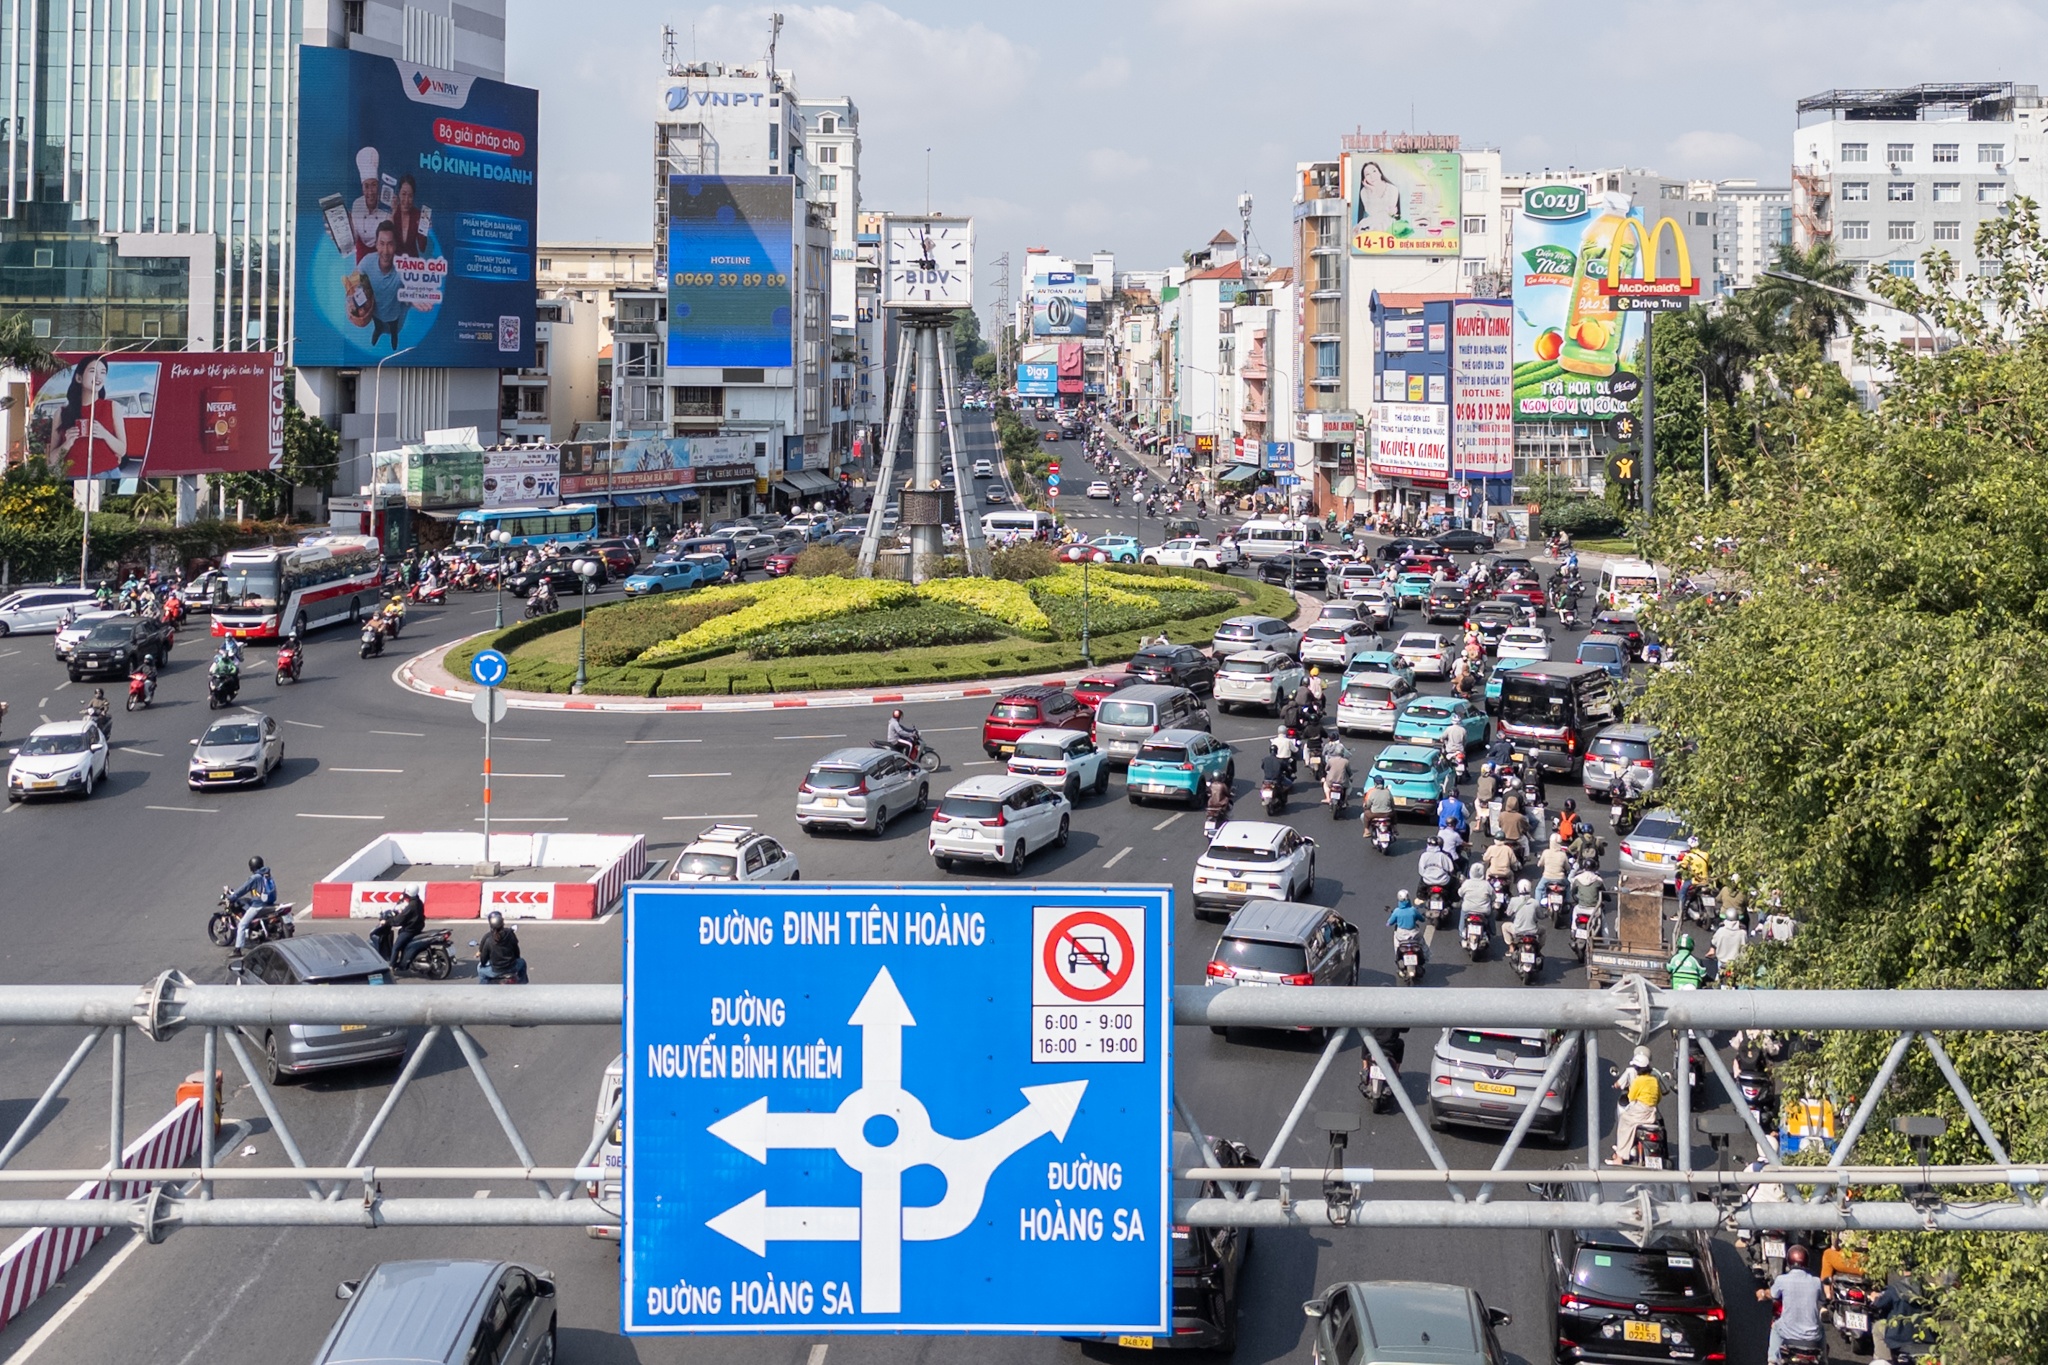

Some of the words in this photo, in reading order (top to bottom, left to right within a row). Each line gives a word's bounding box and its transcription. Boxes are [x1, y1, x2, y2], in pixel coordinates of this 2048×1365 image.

[432, 80, 459, 95] VNPAY
[694, 92, 764, 107] VNPT
[440, 124, 453, 142] Bộ
[454, 127, 473, 144] giải
[475, 131, 500, 149] pháp
[502, 137, 520, 151] cho
[420, 150, 442, 173] HỘ
[444, 157, 481, 178] KINH
[483, 164, 533, 185] DOANH
[1530, 191, 1581, 212] Cozy
[1355, 236, 1395, 249] 14-16
[396, 257, 425, 271] TẶNG
[428, 259, 446, 272] GÓI
[710, 256, 750, 265] HOTLINE
[1537, 257, 1571, 274] Mới
[403, 272, 419, 282] ƯU
[674, 273, 714, 287] 0969
[718, 273, 738, 287] 39
[742, 274, 762, 287] 89
[766, 274, 787, 287] 89
[906, 270, 950, 284] BIDV
[1618, 283, 1680, 293] McDonald's
[1632, 299, 1659, 309] Drive
[1661, 299, 1682, 309] Thru
[1488, 317, 1510, 336] GIANG
[1495, 361, 1505, 370] LED
[1462, 389, 1505, 397] HOTLINE:
[1541, 378, 1564, 395] TRÀ
[1568, 381, 1590, 395] HOA
[1478, 403, 1493, 420] 819
[1496, 403, 1510, 420] 300
[1522, 400, 1547, 411] NGON
[1418, 443, 1445, 460] GIANG
[538, 481, 555, 495] 7K
[699, 909, 773, 946] ĐƯỜNG
[783, 911, 840, 945] ĐINH
[846, 903, 898, 945] TIÊN
[905, 903, 985, 946] HOÀNG
[711, 989, 786, 1027] ĐƯỜNG
[1044, 1015, 1078, 1031] 6:00
[1099, 1014, 1133, 1031] 9:00
[1038, 1037, 1077, 1054] 16:00
[1099, 1037, 1138, 1053] 19:00
[648, 1033, 726, 1079] NGUYỄN
[731, 1033, 778, 1079] BỈNH
[782, 1037, 842, 1079] KHIÊM
[1047, 1158, 1122, 1192] ĐƯỜNG
[1019, 1200, 1103, 1242] HOÀNG
[1112, 1208, 1146, 1242] SA
[647, 1279, 721, 1316] ĐƯỜNG
[731, 1272, 814, 1316] HOÀNG
[821, 1280, 855, 1316] SA
